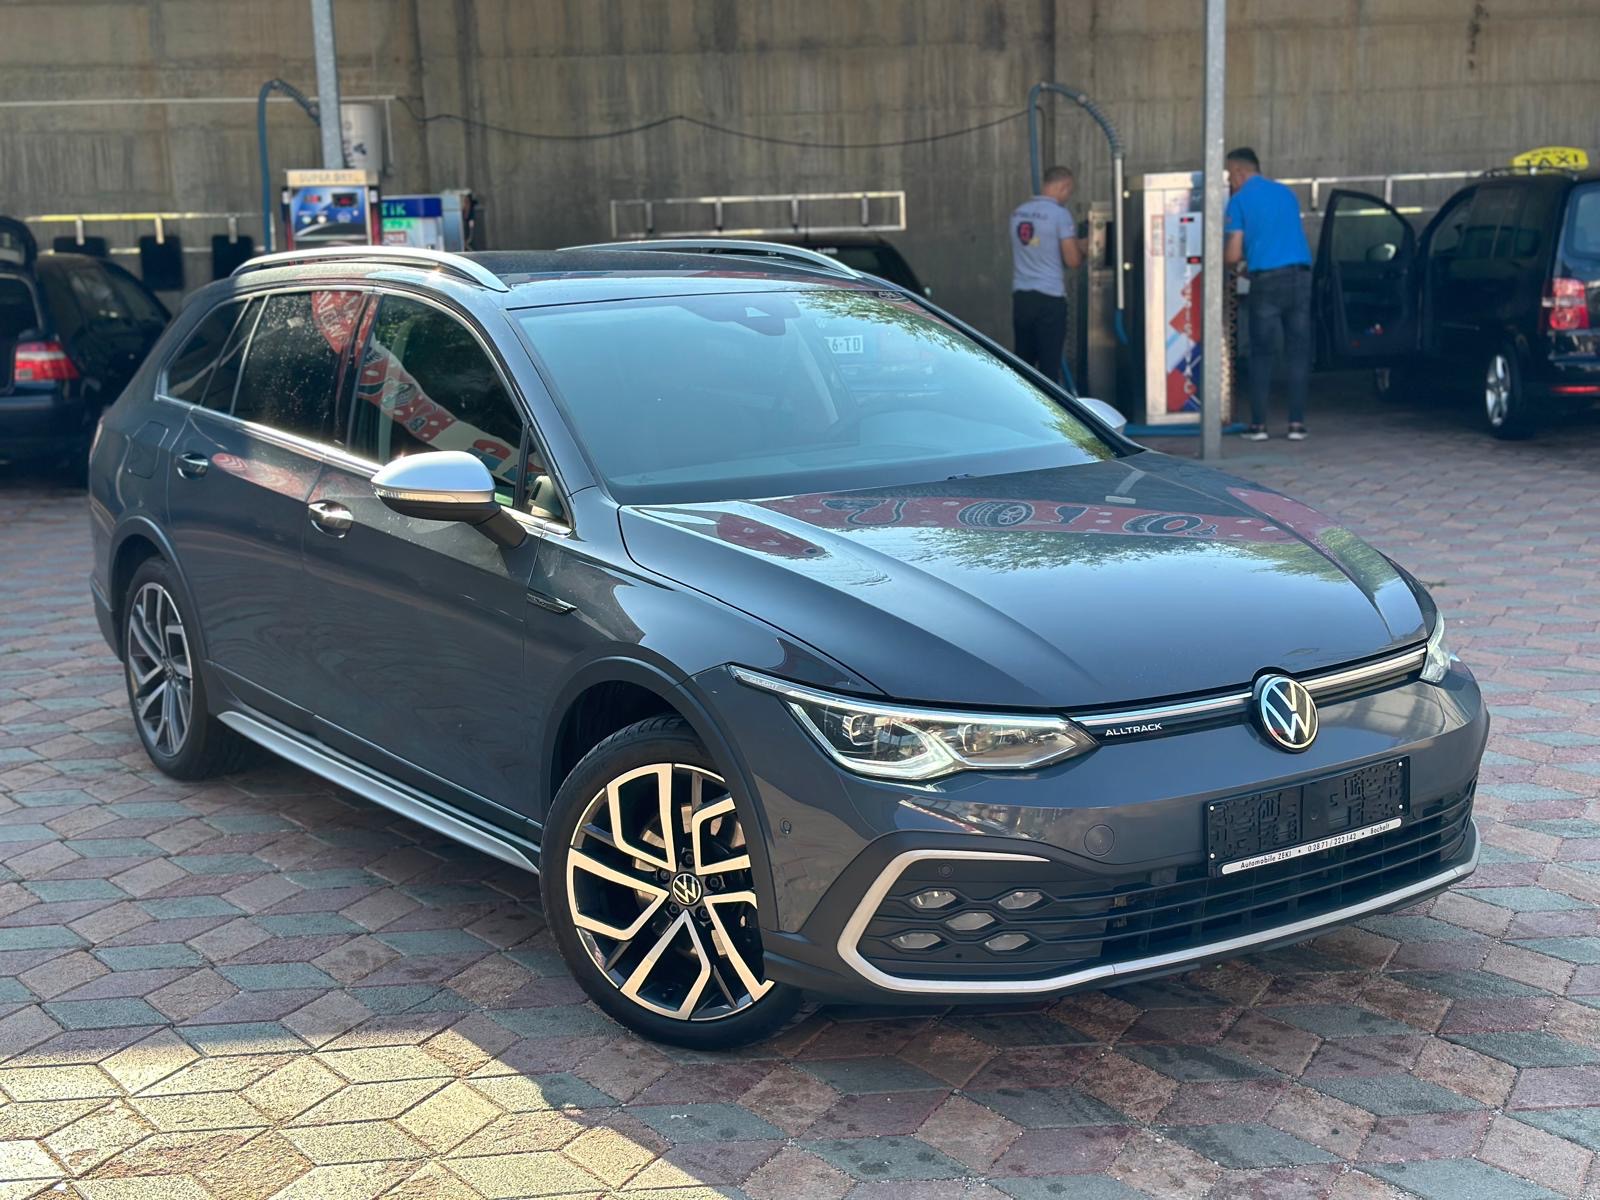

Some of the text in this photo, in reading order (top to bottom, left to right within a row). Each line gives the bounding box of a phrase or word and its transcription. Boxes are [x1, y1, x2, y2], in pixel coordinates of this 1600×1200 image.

[1519, 153, 1579, 169] TAXI
[1105, 722, 1163, 737] ALLTRACK
[1240, 854, 1276, 869] Automobile
[1277, 851, 1292, 860] ZEKI
